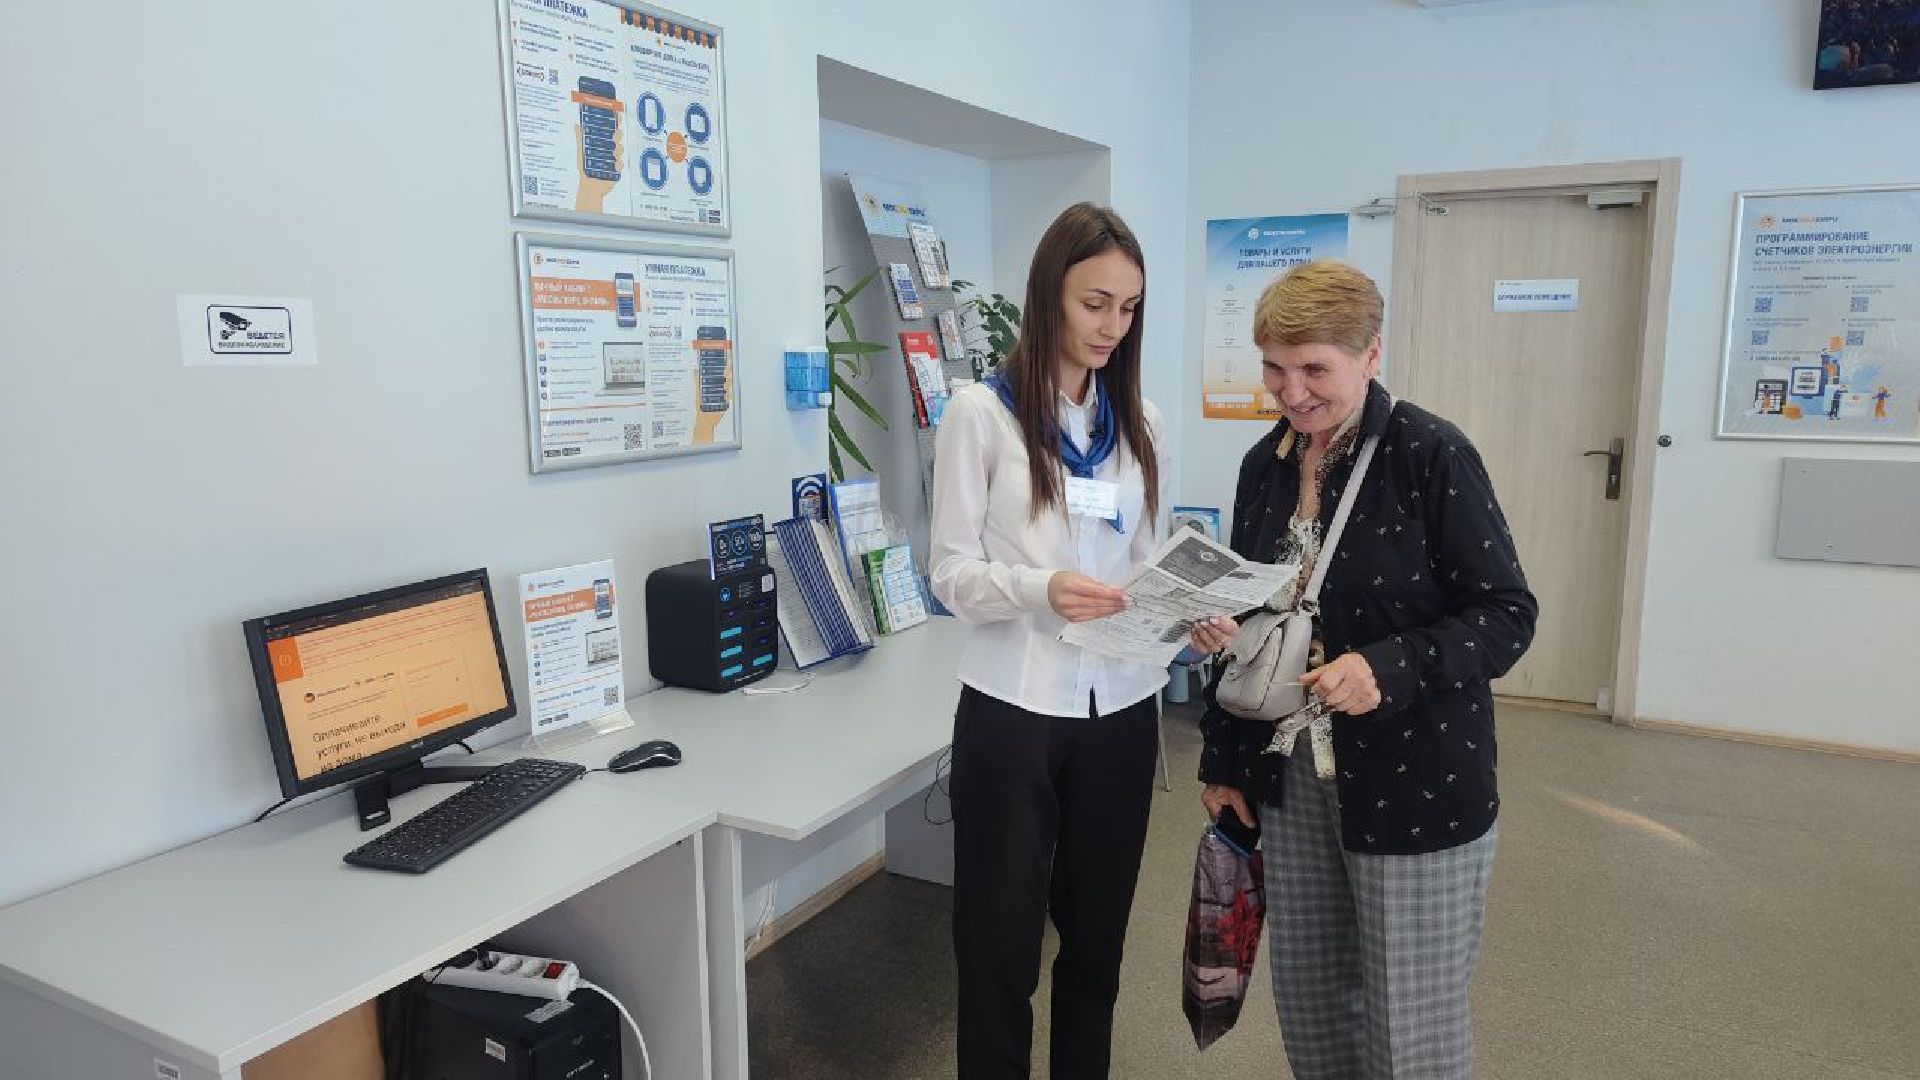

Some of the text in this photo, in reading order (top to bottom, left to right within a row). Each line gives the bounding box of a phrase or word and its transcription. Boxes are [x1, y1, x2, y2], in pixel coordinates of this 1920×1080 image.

[1755, 231, 1870, 244] ПРОГРАММИРОВАНИЕ
[1239, 248, 1271, 257] ТОВАРЫ
[1280, 246, 1312, 256] УСЛУГИ
[1754, 243, 1913, 257] СЧЕТЧИКОВ ЭЛЕКТРОЭНЕРГИИ
[313, 714, 381, 742] Оплачивайте
